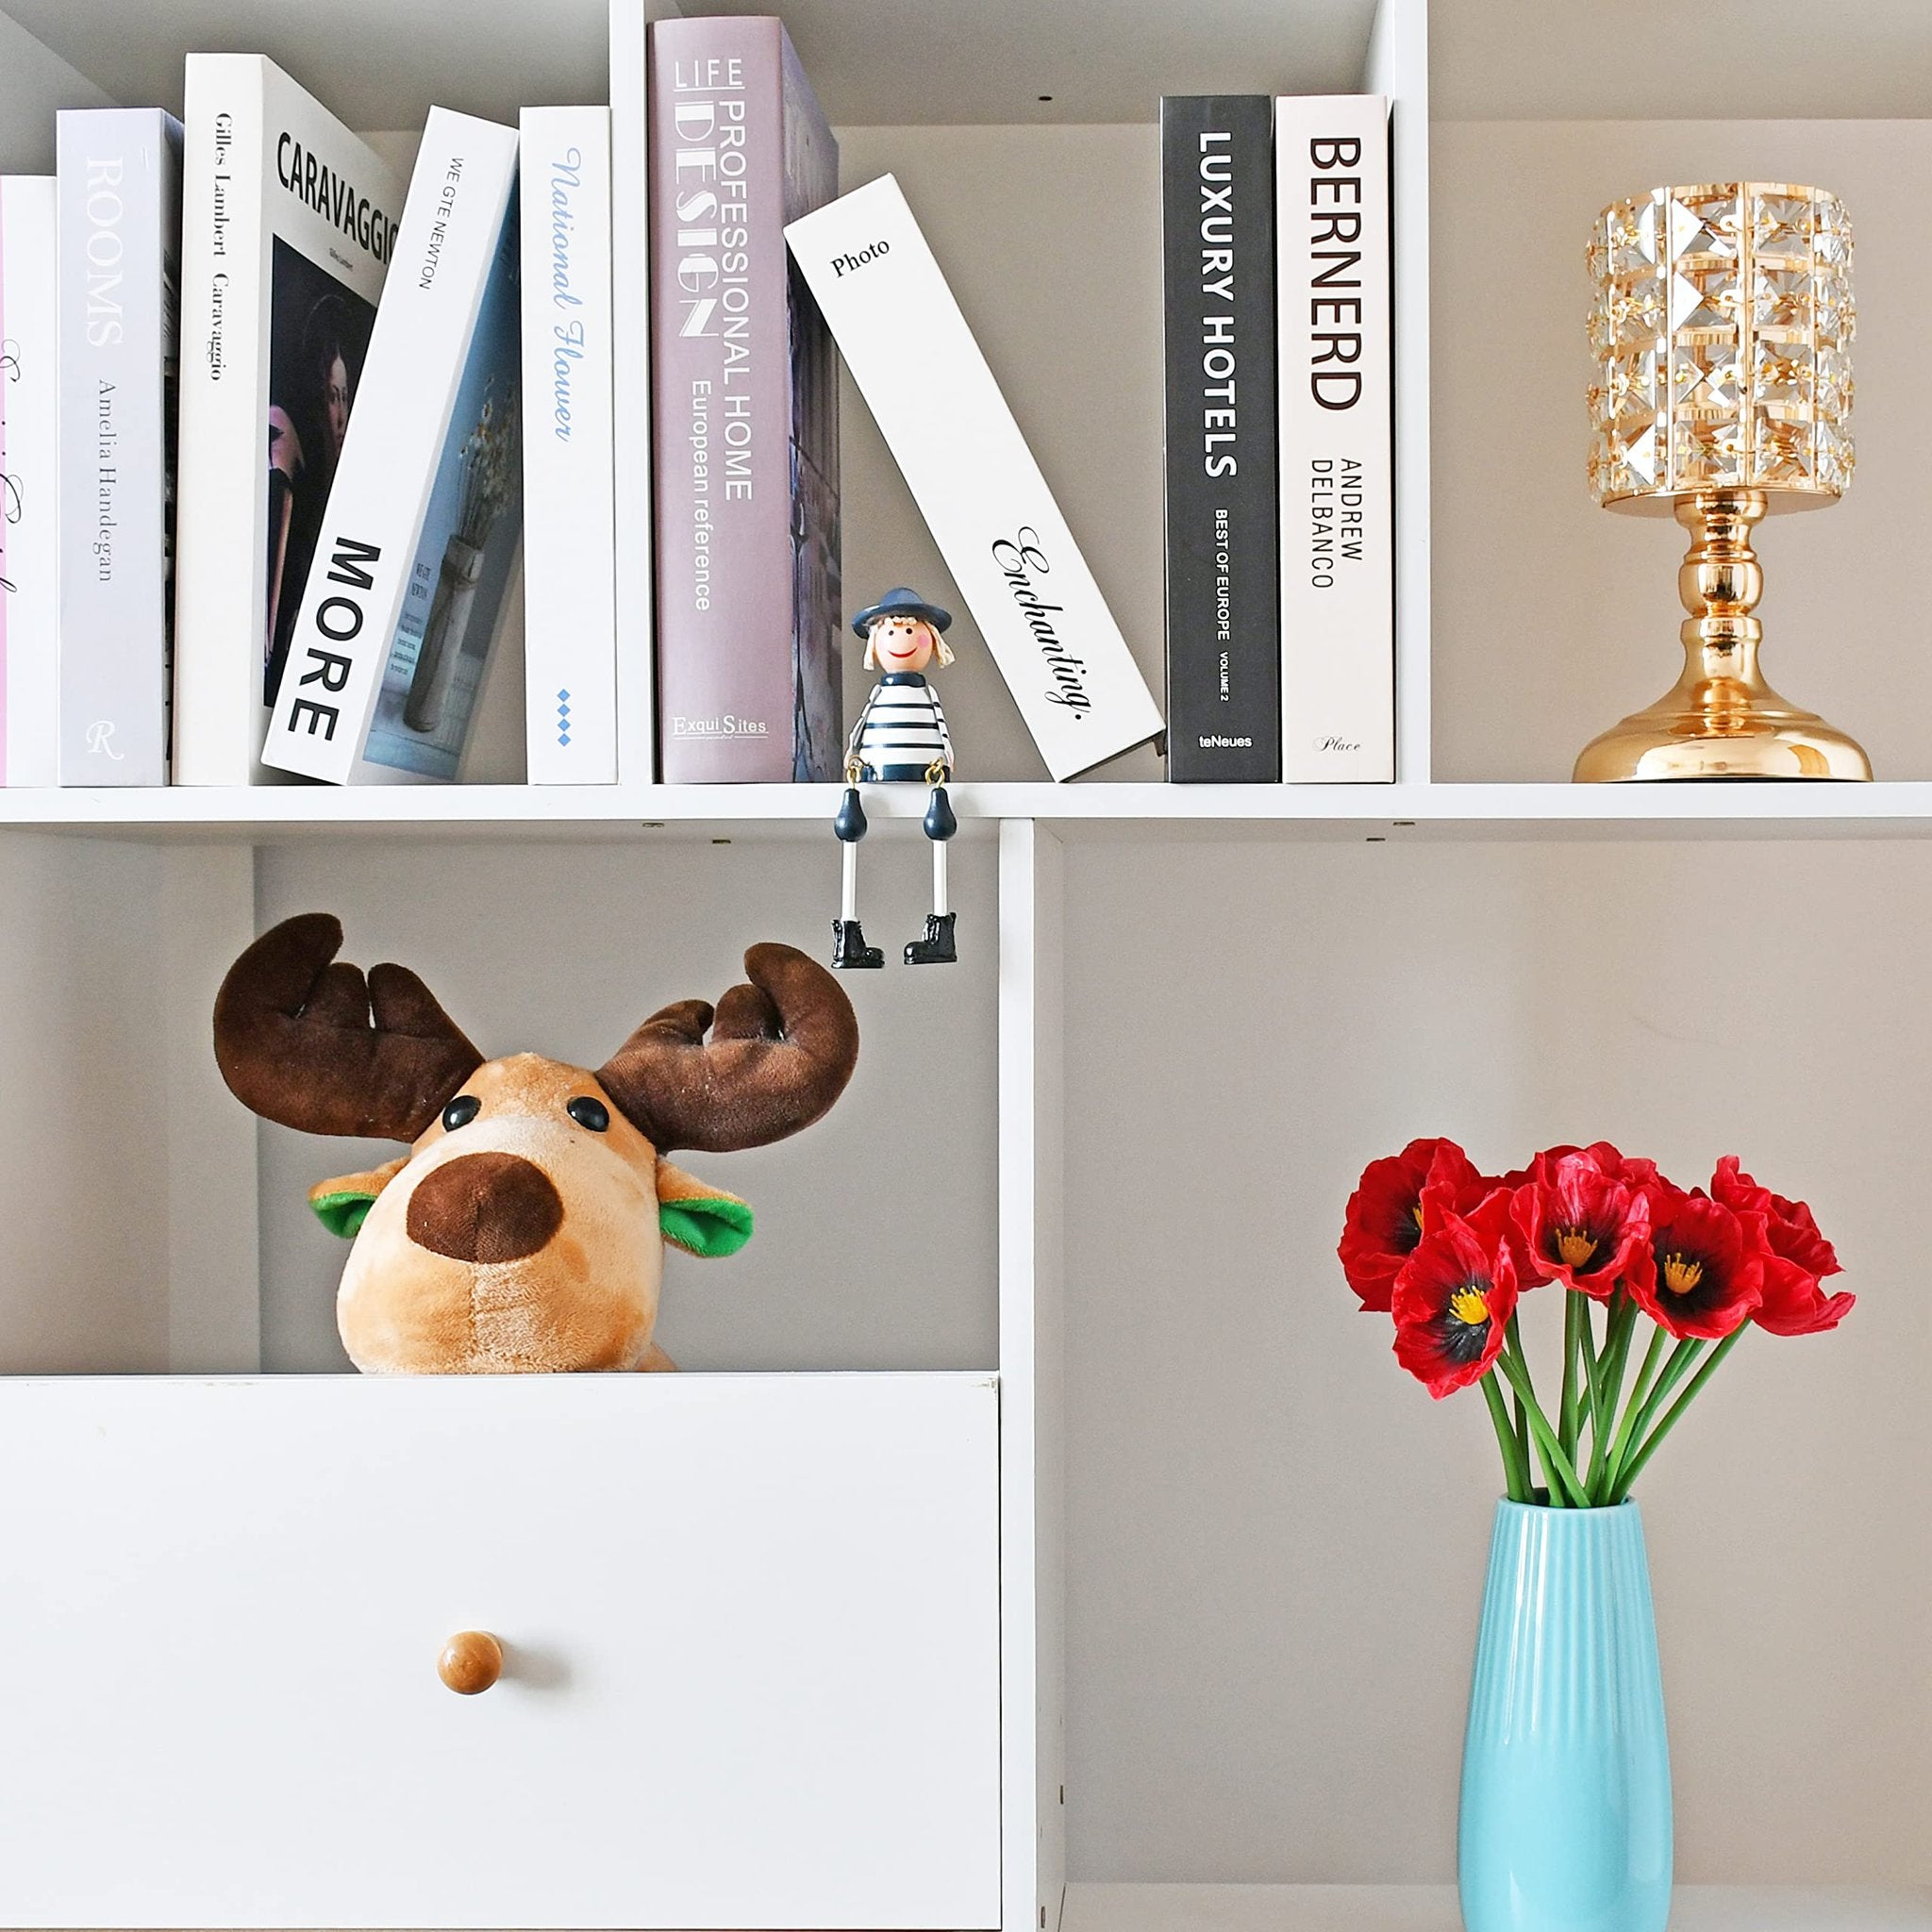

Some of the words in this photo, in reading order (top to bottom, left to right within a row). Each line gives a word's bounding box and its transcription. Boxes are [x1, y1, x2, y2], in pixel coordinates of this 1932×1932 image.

[675, 58, 742, 88] LIFE
[215, 112, 232, 166] Gilles
[446, 158, 464, 182] WE
[86, 157, 123, 347] ROOMS
[213, 175, 230, 257] Lambert
[437, 185, 456, 218] GTE
[550, 147, 583, 311] National
[675, 101, 720, 339] DESIGN
[719, 100, 750, 385] PROFESSIONAL
[1198, 132, 1235, 302] LUXURY
[418, 221, 447, 290] NEWTON
[830, 240, 890, 277] Photo
[1310, 137, 1362, 411] BERNERD
[207, 273, 228, 381] Caravaggio
[99, 379, 117, 458] Amelia
[553, 320, 585, 442] Flower
[1202, 314, 1238, 478] HOTELS
[688, 380, 712, 493] European
[724, 395, 752, 501] HOME
[93, 468, 117, 582] Handegan
[692, 498, 713, 611] reference
[1214, 508, 1229, 549] BEST
[1215, 551, 1230, 574] OF
[1311, 460, 1333, 589] DELBANCO
[1341, 458, 1362, 562] ANDREW
[288, 536, 382, 742] MORE
[992, 526, 1091, 720] Enchanting.
[1215, 575, 1231, 641] EUROPE
[1219, 651, 1231, 693] VOLUME
[1219, 693, 1231, 702] 2
[1199, 736, 1253, 748] teNeues
[1313, 735, 1361, 752] Place
